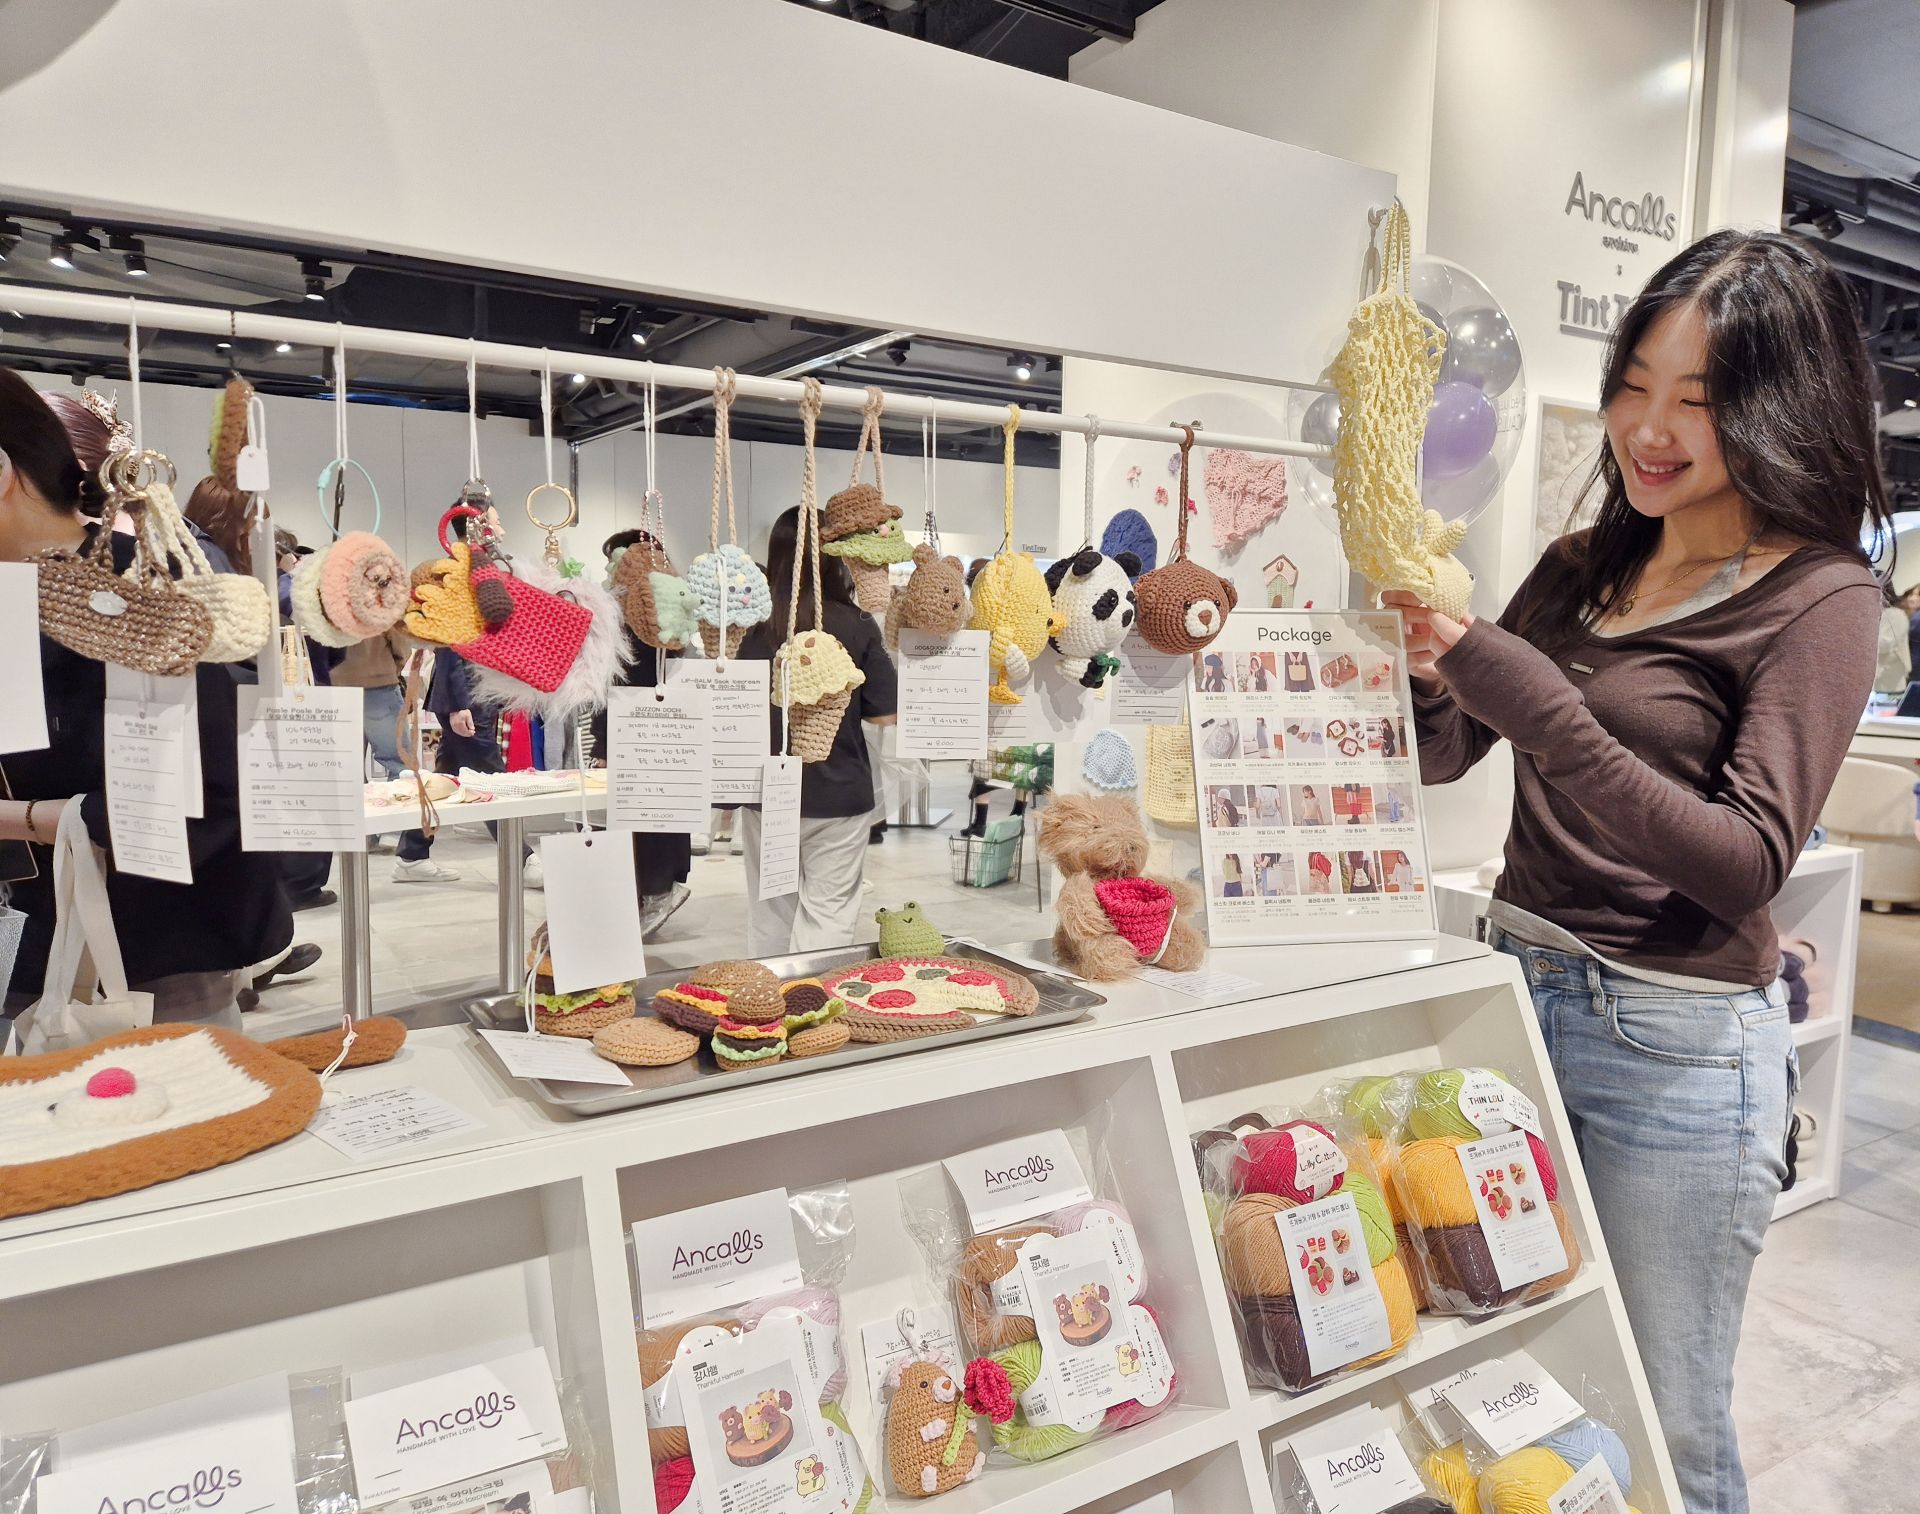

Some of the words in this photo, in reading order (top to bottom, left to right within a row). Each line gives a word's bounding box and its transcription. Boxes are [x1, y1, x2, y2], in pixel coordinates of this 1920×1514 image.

[1565, 171, 1676, 242] Ancalls
[1257, 627, 1332, 645] Package
[1468, 1095, 1487, 1105] THIN
[984, 1155, 1055, 1187] Ancalls
[1299, 1160, 1315, 1172] Lolly
[1315, 1151, 1338, 1164] Cotton
[988, 1185, 1011, 1194] HANDMADE
[672, 1229, 764, 1271] Ancalls
[1112, 1240, 1123, 1265] Cotton
[672, 1268, 703, 1280] HANDMADE
[704, 1264, 718, 1272] WITH
[719, 1260, 733, 1268] LOVE
[693, 1364, 718, 1383] 감사햄
[697, 1377, 721, 1390] Thankful
[721, 1367, 745, 1381] Hamster
[1482, 1381, 1540, 1417] Ancalls
[396, 1391, 516, 1445] Ancalls
[397, 1438, 437, 1454] HANDMADE
[439, 1431, 458, 1441] WITH
[458, 1425, 476, 1435] LOVE
[1327, 1442, 1385, 1481] Ancalls
[98, 1465, 242, 1514] Ancalls
[450, 1479, 504, 1498] 아이스크림
[466, 1490, 499, 1504] Icecream
